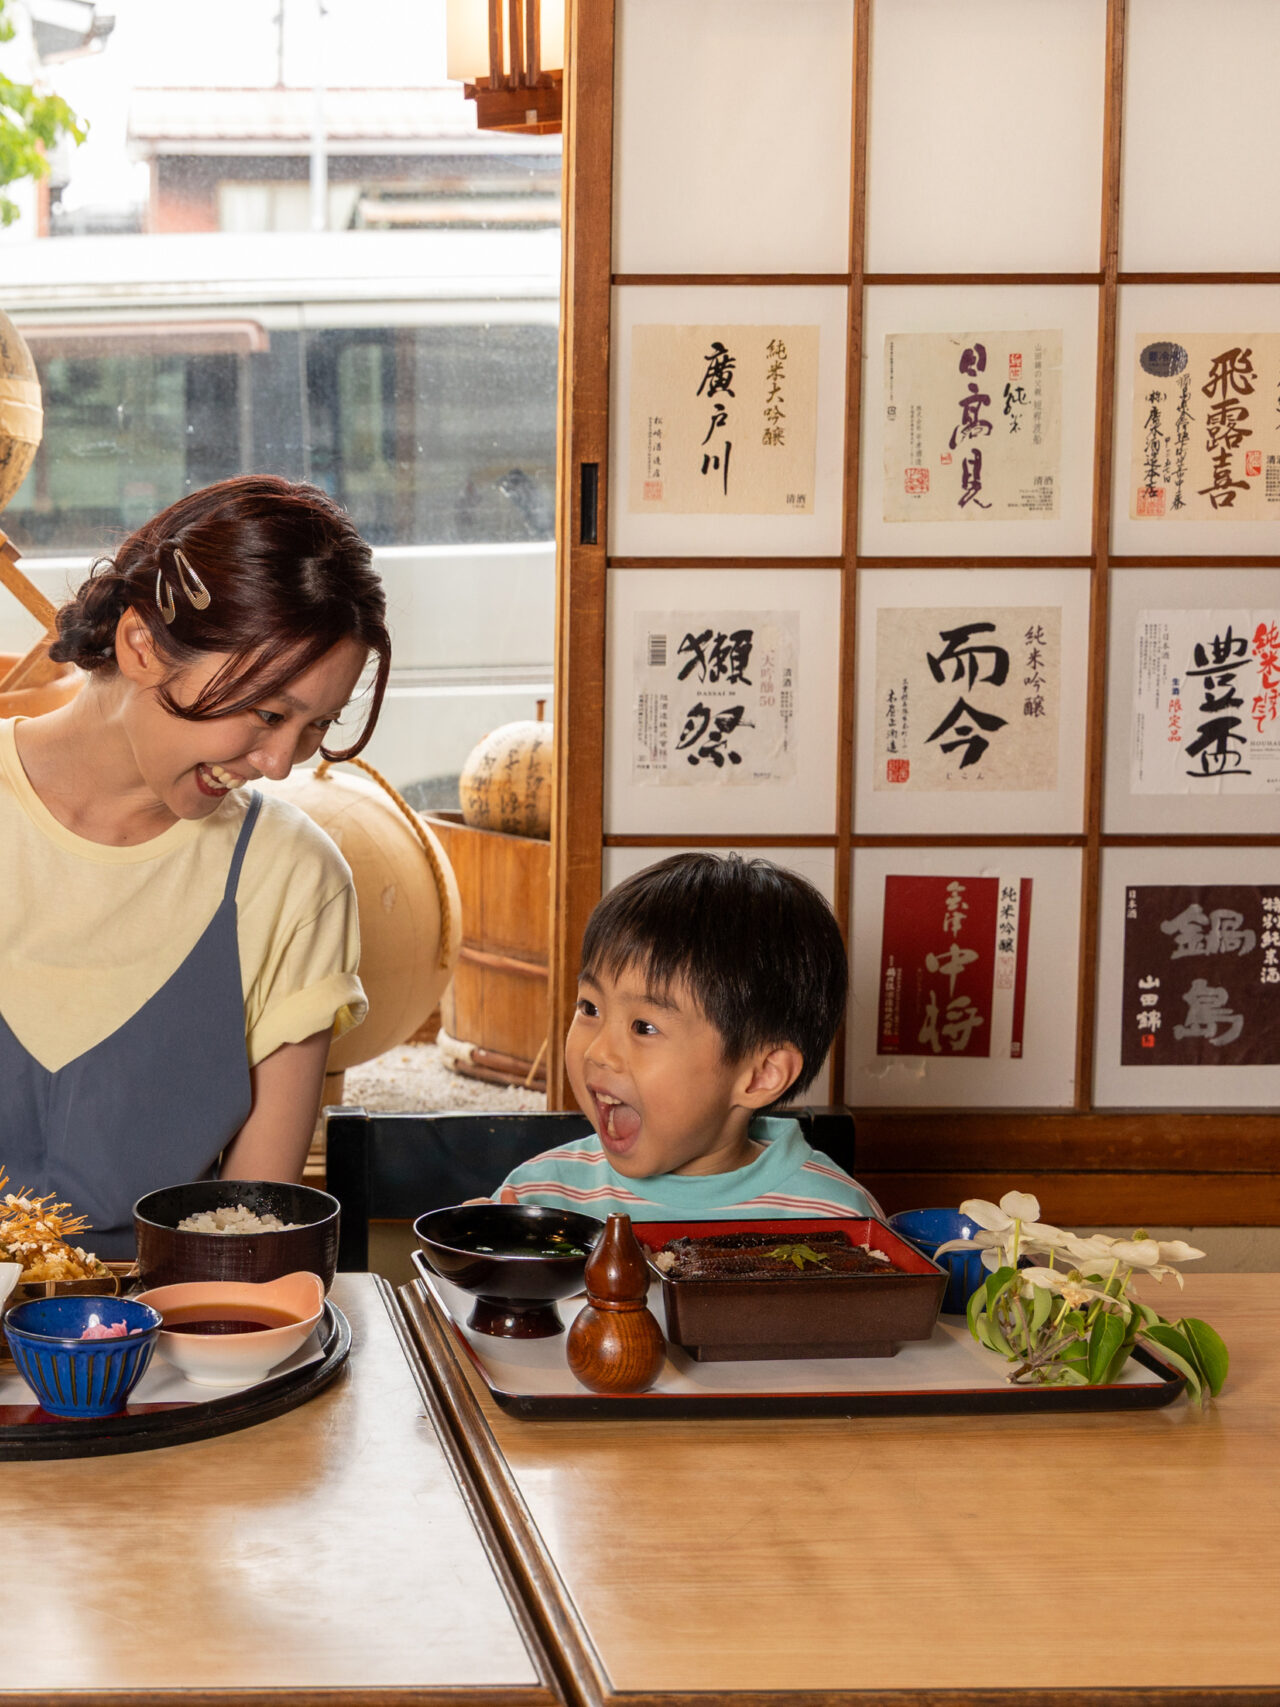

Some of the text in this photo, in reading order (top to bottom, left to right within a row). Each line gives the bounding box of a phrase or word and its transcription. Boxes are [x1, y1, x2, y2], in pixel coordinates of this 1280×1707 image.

[696, 341, 737, 496] 廣戸川
[761, 338, 788, 447] 純米大吟醸
[948, 342, 993, 509] 日高見
[1003, 382, 1032, 434] 純米
[1198, 347, 1258, 510] 飛露喜
[786, 493, 806, 504] 清酒
[1033, 475, 1054, 486] 清酒
[675, 629, 756, 768] 獺祭
[924, 622, 1010, 770] 而今
[1023, 624, 1047, 719] 純米吟醸
[1167, 698, 1183, 742] 限定品
[1185, 624, 1254, 777] 豊盃
[997, 886, 1017, 954] 純米吟醸
[1127, 889, 1137, 919] 日本酒
[1136, 974, 1162, 1034] 山田錦
[1159, 903, 1257, 1047] 鍋島
